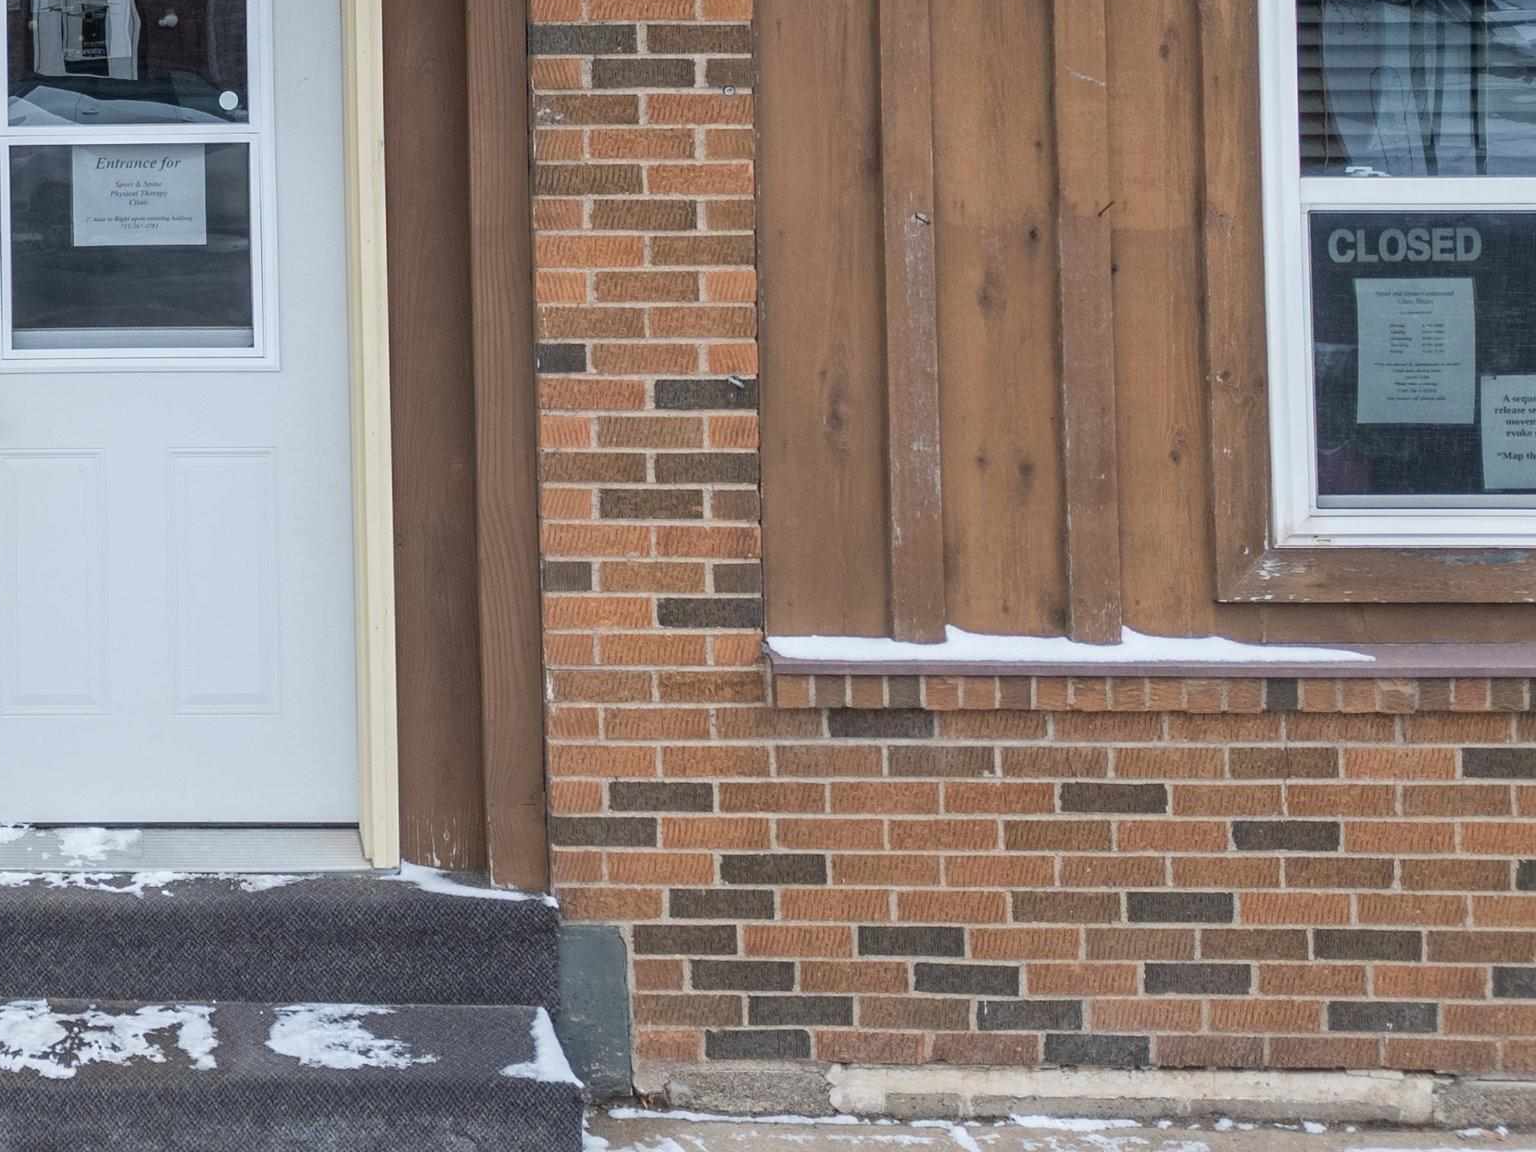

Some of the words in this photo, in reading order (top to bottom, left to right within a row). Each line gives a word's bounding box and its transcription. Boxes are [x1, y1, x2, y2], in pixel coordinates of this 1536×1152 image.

[96, 156, 157, 170] Entrance
[159, 156, 181, 171] for
[1327, 227, 1483, 264] CLOSED
